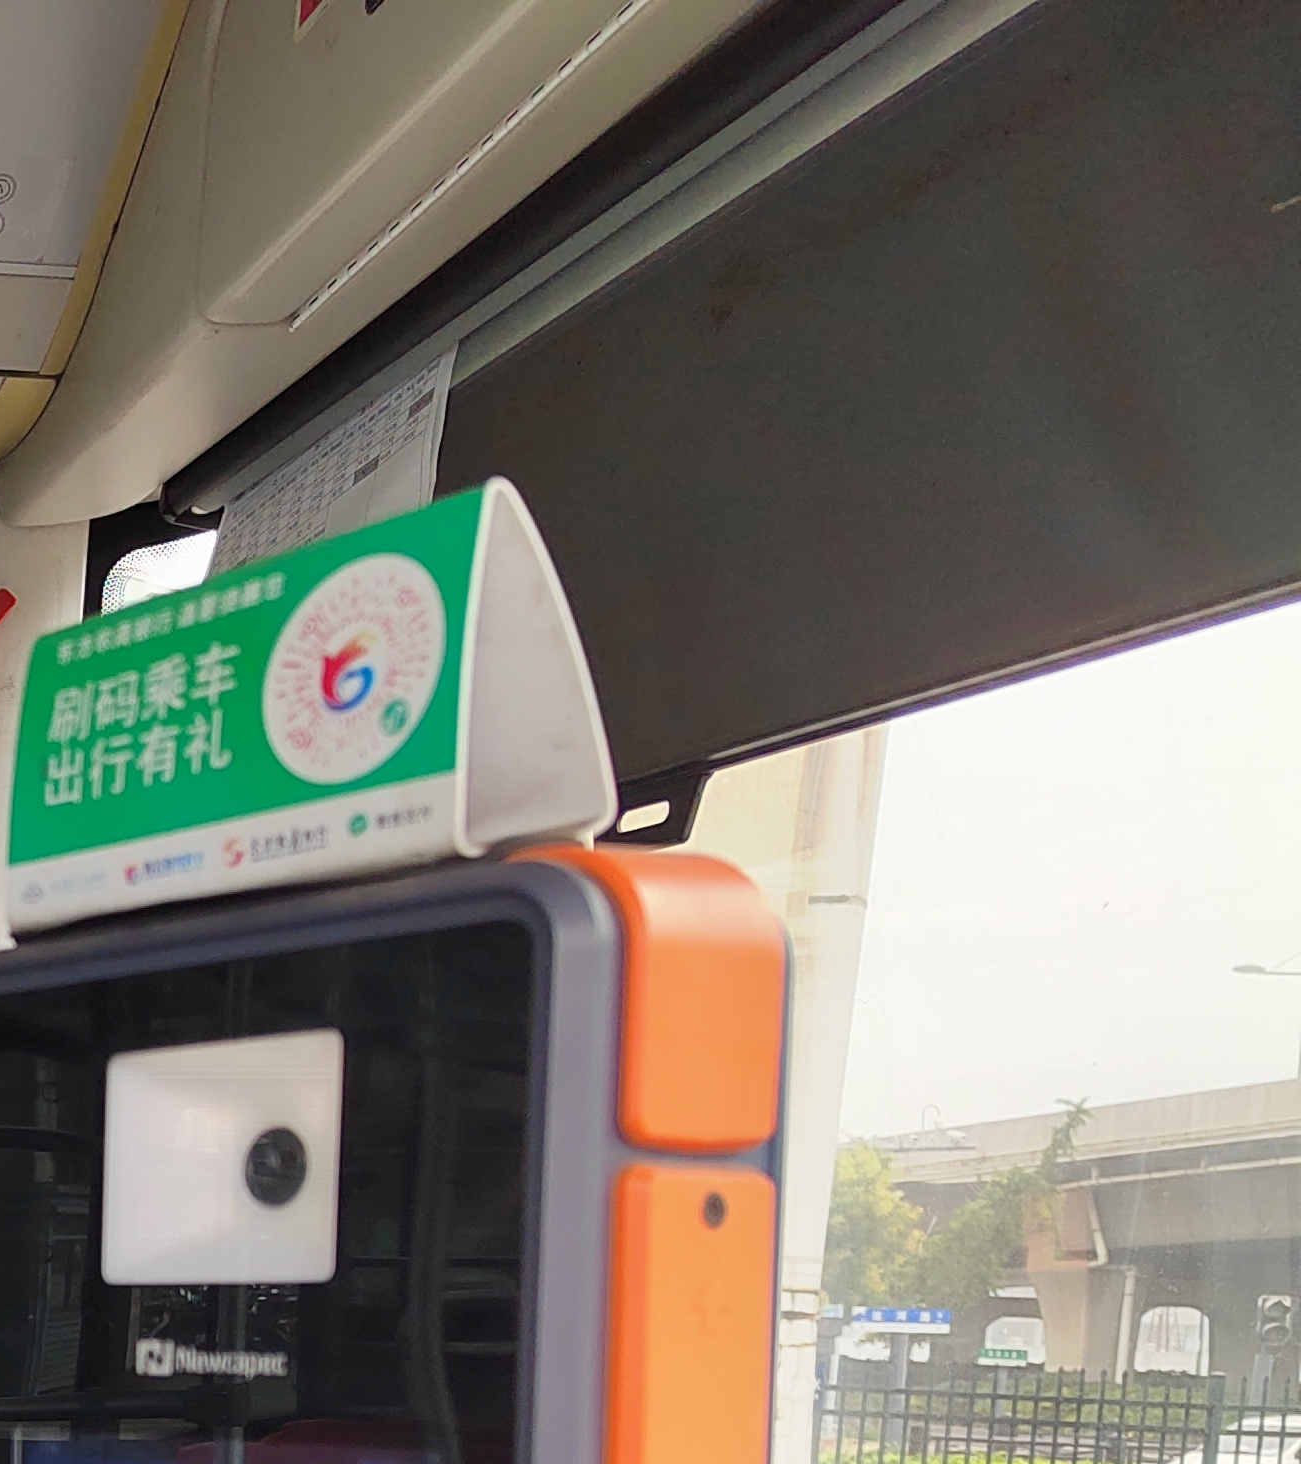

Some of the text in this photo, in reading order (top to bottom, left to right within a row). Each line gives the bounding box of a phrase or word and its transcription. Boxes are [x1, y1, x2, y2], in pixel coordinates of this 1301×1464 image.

[46, 640, 242, 743] 刷码乘车
[43, 706, 234, 807] 出行有礼
